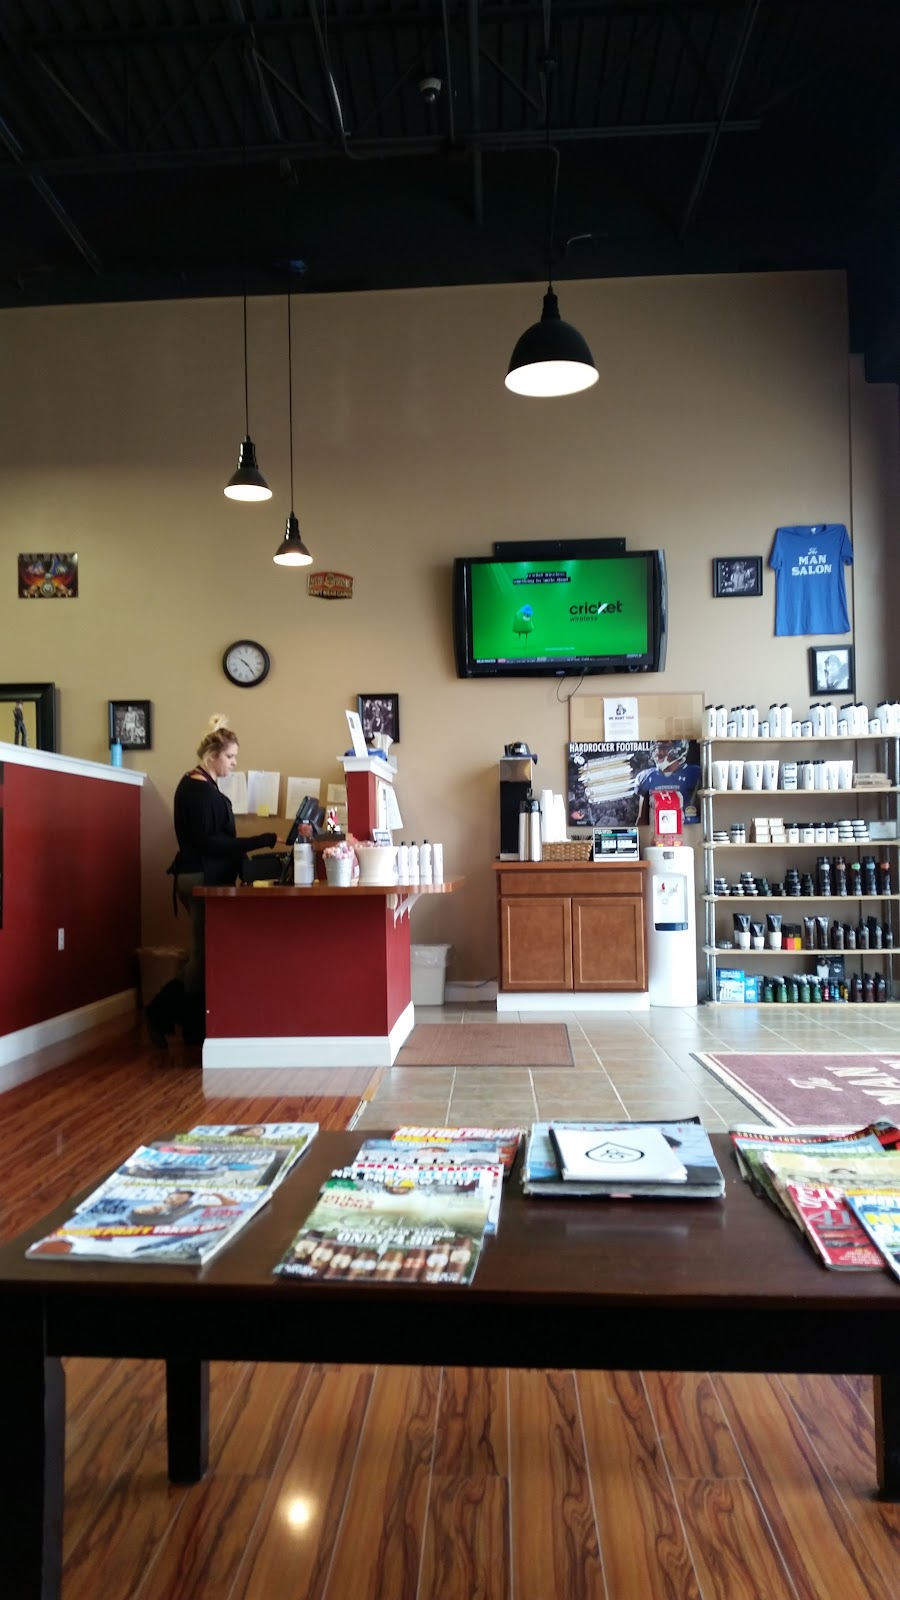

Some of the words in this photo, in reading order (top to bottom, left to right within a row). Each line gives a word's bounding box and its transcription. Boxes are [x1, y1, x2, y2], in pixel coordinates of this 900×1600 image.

[798, 555, 827, 566] MAN
[791, 564, 832, 576] SALON
[569, 601, 622, 615] cricket
[569, 742, 615, 752] HARDROCKER
[616, 742, 650, 752] FOOTBALL
